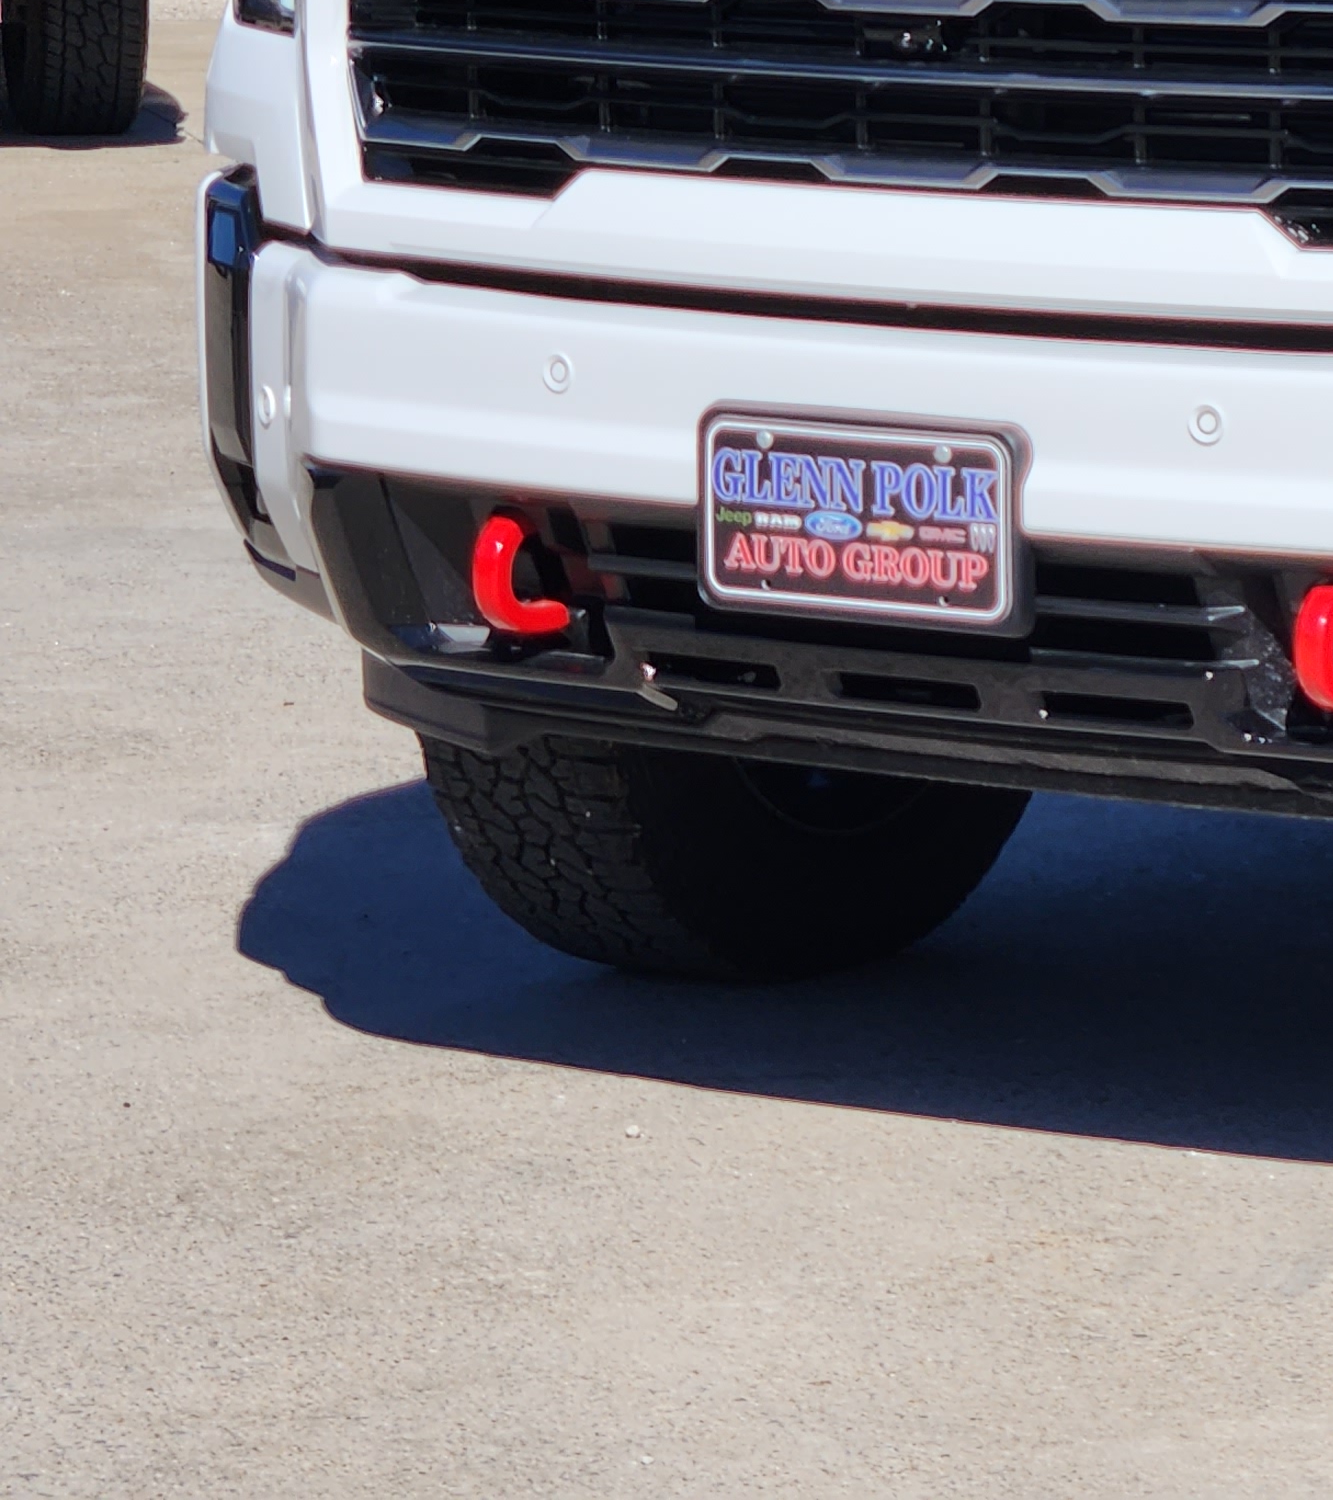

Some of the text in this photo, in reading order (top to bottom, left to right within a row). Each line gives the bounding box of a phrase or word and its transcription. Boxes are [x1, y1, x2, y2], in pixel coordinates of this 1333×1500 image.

[712, 447, 999, 522] GLENN POLK
[716, 506, 752, 527] Jeep
[754, 510, 801, 530] RAM
[918, 525, 967, 544] GMC
[724, 532, 988, 591] AUTO GROUP
